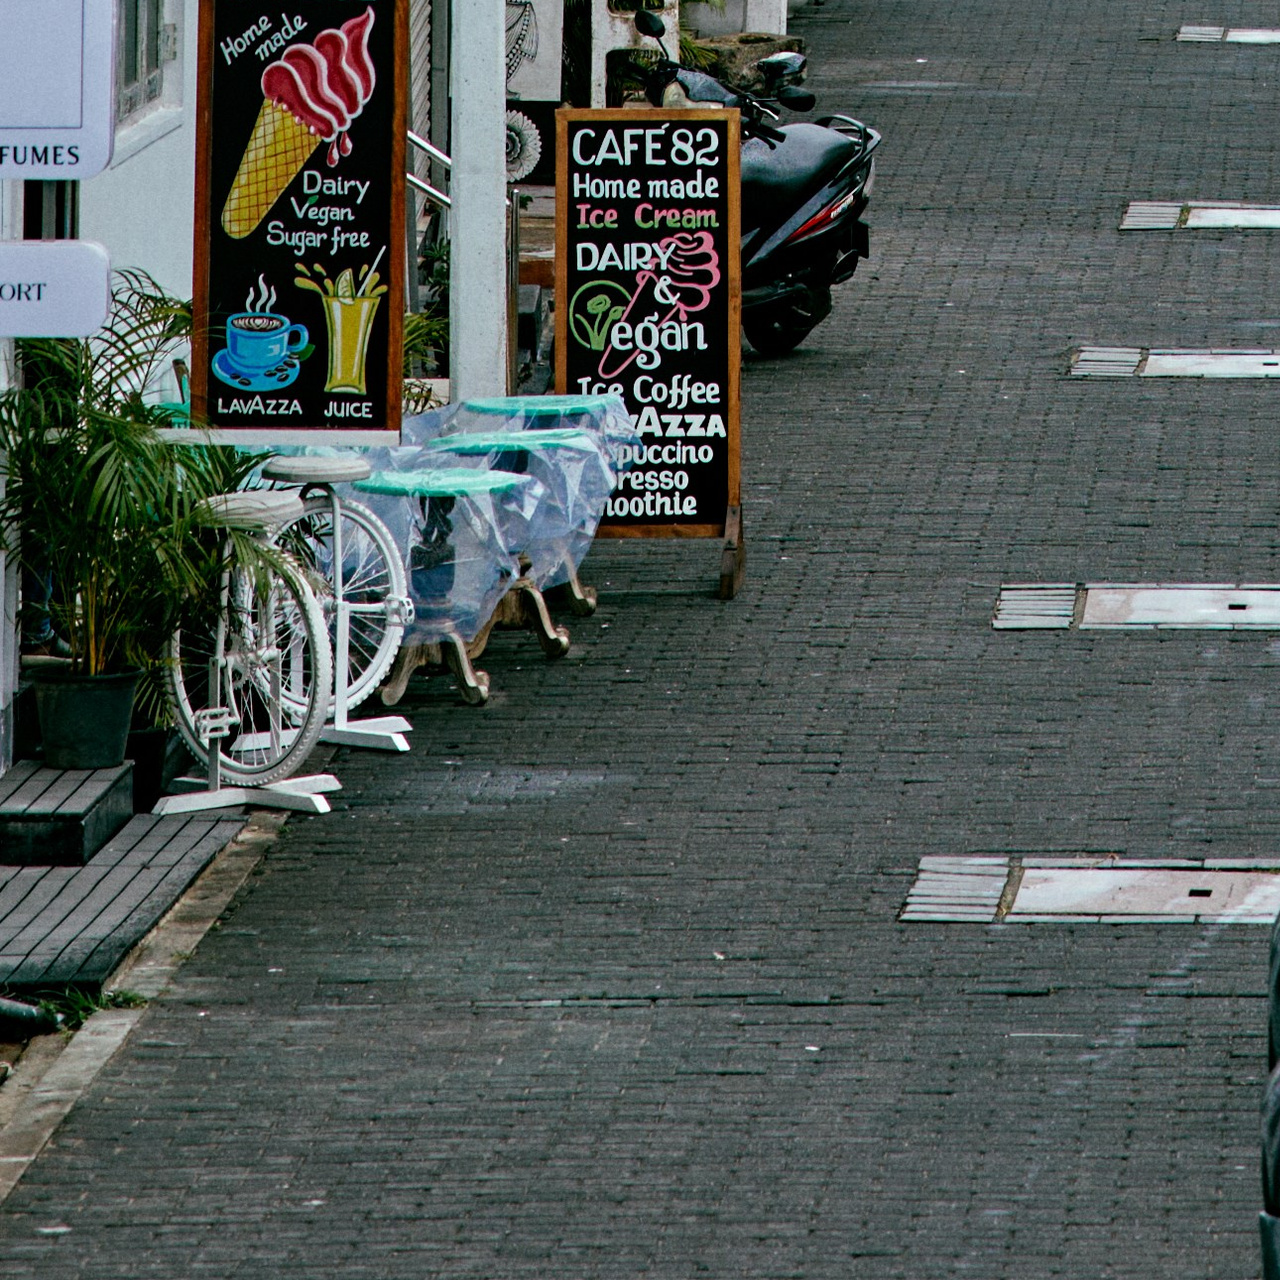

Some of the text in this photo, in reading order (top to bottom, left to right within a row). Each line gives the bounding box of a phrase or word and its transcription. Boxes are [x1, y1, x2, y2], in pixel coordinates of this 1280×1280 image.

[219, 15, 272, 65] Home
[254, 12, 308, 62] made
[0, 145, 80, 167] FUMES
[573, 123, 720, 166] CAFÉ 82
[303, 171, 370, 204] Dairy
[573, 169, 719, 200] Home made
[290, 197, 356, 227] Vegan
[576, 204, 720, 229] Ice Cream
[267, 221, 371, 256] Sugar free
[576, 243, 676, 272] DAIRY
[0, 283, 47, 302] ORT
[653, 275, 681, 306] &
[217, 394, 373, 419] LAVAZZA JUICE
[633, 374, 721, 409] Coffee
[630, 406, 727, 438] AZZA
[616, 440, 714, 470] puccino
[617, 470, 689, 490] resso
[601, 491, 698, 517] oothie
